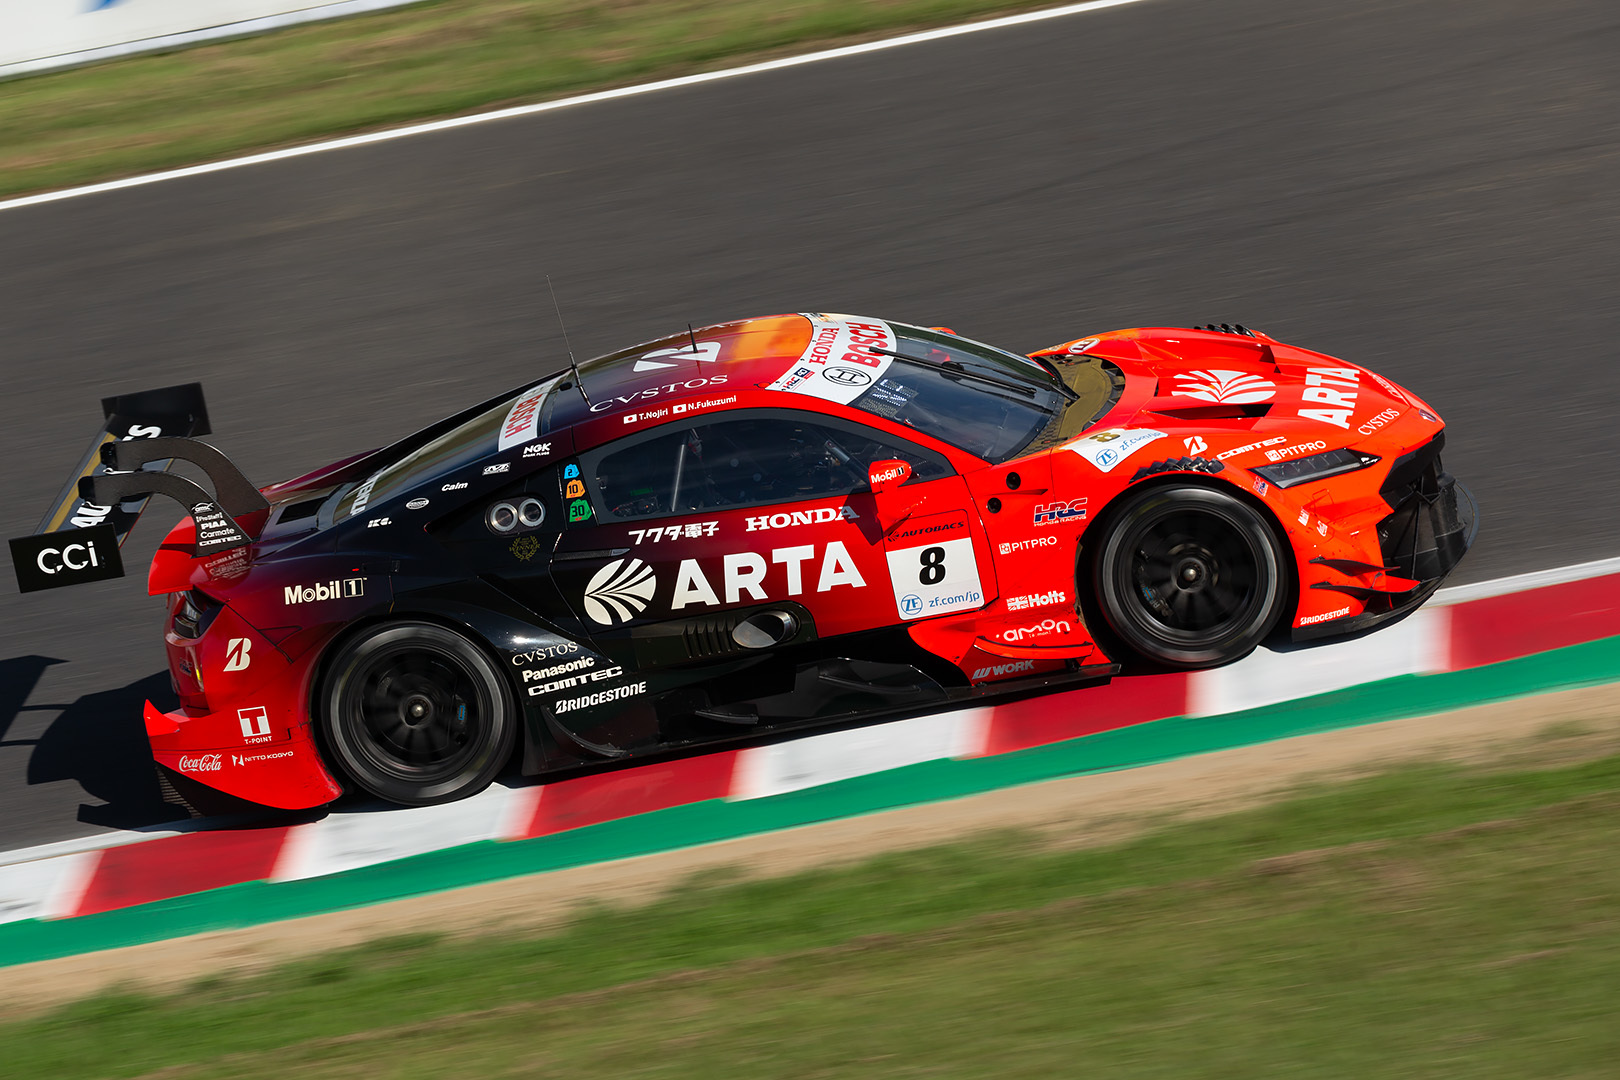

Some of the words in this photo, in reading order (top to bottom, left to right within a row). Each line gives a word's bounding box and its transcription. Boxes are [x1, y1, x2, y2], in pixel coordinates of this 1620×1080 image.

[809, 327, 840, 365] HONDA
[841, 322, 888, 368] BOSCH
[590, 374, 728, 413] CVSTOS
[1297, 367, 1361, 430] ARTA
[1358, 408, 1400, 435] CVSTOS
[523, 442, 552, 454] NGK
[1216, 436, 1287, 460] COMTEC
[1278, 440, 1327, 459] PITPRO
[870, 468, 898, 484] Mobil
[568, 484, 579, 495] 10
[571, 504, 585, 517] 30
[745, 505, 860, 532] HONDA
[1034, 497, 1088, 523] HRC
[200, 519, 228, 530] PIAA
[200, 527, 235, 539] Carmate
[901, 521, 965, 538] AUTOBACS
[1011, 536, 1058, 552] PITPRO
[671, 540, 867, 610] ARTA
[919, 547, 946, 586] 8
[284, 581, 341, 606] Mobil
[928, 590, 981, 609] zf.com/jp
[1028, 590, 1066, 608] Holts
[1300, 606, 1350, 626] BRIDGESTONE
[1003, 619, 1071, 642] amon
[511, 641, 579, 667] CVSTOS
[522, 655, 596, 683] Panasonic
[993, 659, 1034, 676] WORK
[528, 665, 624, 697] COMTEC
[555, 681, 648, 715] BRIDGESTONE
[244, 735, 273, 745] T-POINT
[244, 754, 267, 763] NITTO
[266, 750, 295, 760] KOGYO
